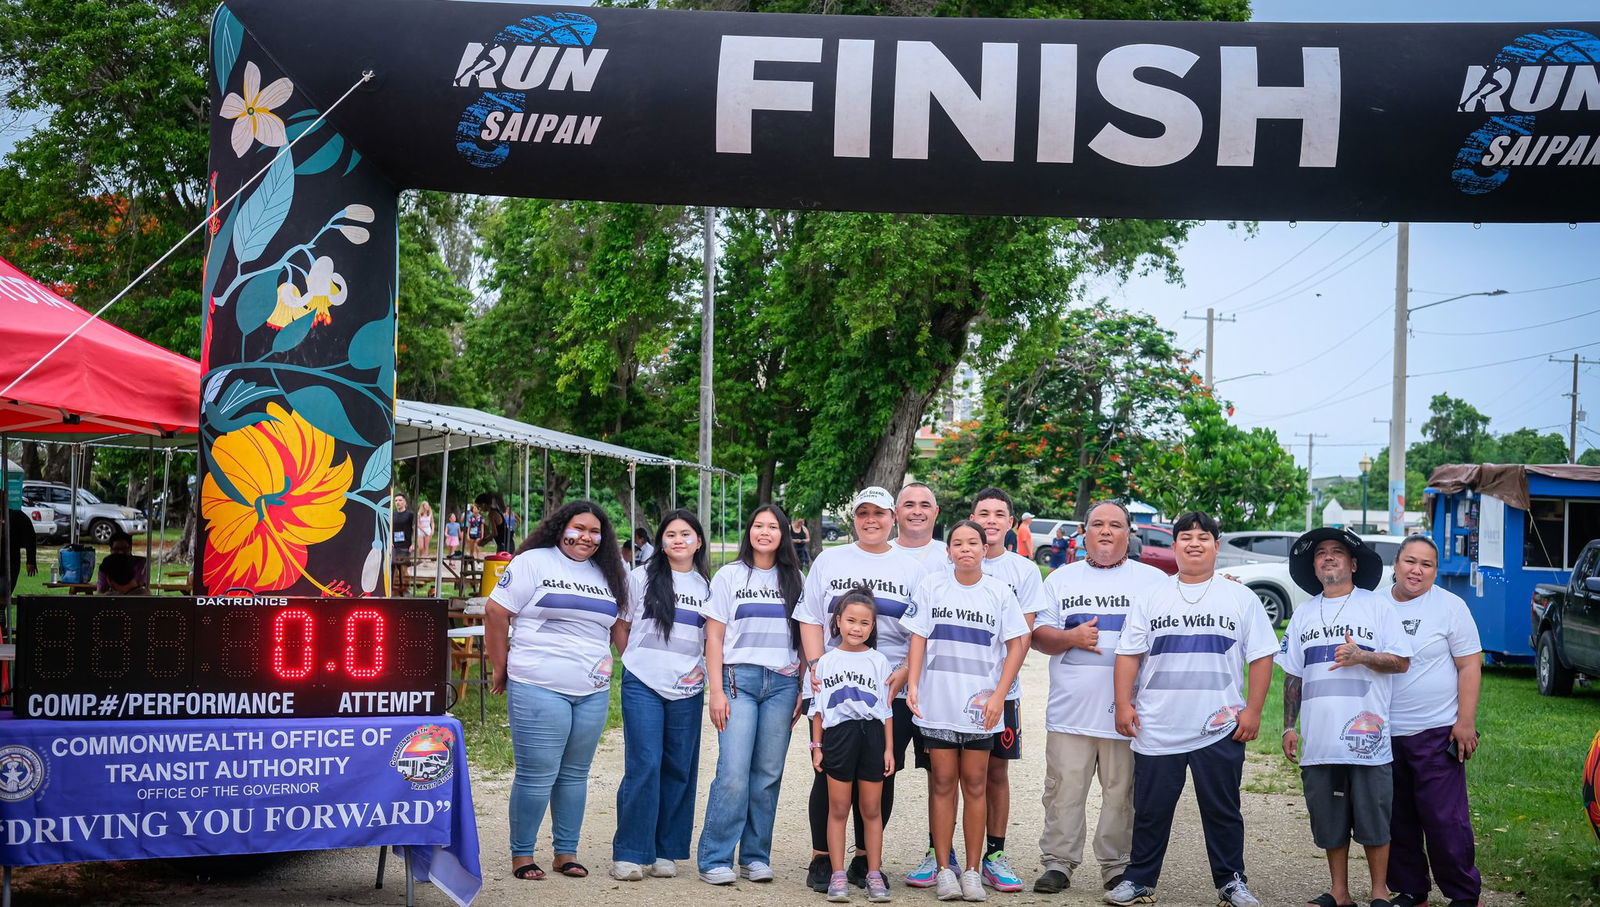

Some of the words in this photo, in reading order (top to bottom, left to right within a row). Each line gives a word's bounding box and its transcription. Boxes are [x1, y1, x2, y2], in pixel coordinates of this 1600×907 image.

[453, 42, 609, 92] RUN
[715, 34, 1341, 168] FINISH
[480, 111, 602, 145] SAIPAN
[542, 579, 571, 589] Ride
[573, 582, 604, 595] With
[736, 589, 758, 599] Ride
[830, 577, 859, 590] Ride
[862, 578, 897, 594] With
[196, 597, 288, 606] DAKTRONICS
[1061, 595, 1092, 610] Ride
[1095, 595, 1130, 607] With
[932, 606, 953, 618] Ride
[956, 608, 983, 623] With
[986, 613, 996, 627] Us
[1150, 614, 1179, 631] Ride
[1182, 613, 1215, 627] With
[1219, 615, 1236, 631] Us
[273, 610, 384, 679] 0.0
[1300, 628, 1320, 646] Ride
[1322, 624, 1354, 638] With
[1357, 626, 1374, 640] Us
[823, 673, 843, 688] Ride
[844, 670, 866, 685] With
[867, 677, 877, 691] Us
[338, 691, 435, 713] ATTEMPT
[51, 732, 263, 757] COMMONWEALTH
[271, 728, 354, 749] OFFICE
[361, 727, 392, 746] OF
[105, 761, 209, 783] TRANSIT
[215, 756, 350, 779] AUTHORITY
[137, 787, 186, 800] OFFICE
[190, 786, 209, 798] OF
[212, 785, 239, 797] THE
[243, 782, 319, 796] GOVERNOR
[177, 807, 255, 836] YOU
[264, 800, 451, 832] FORWARD”
